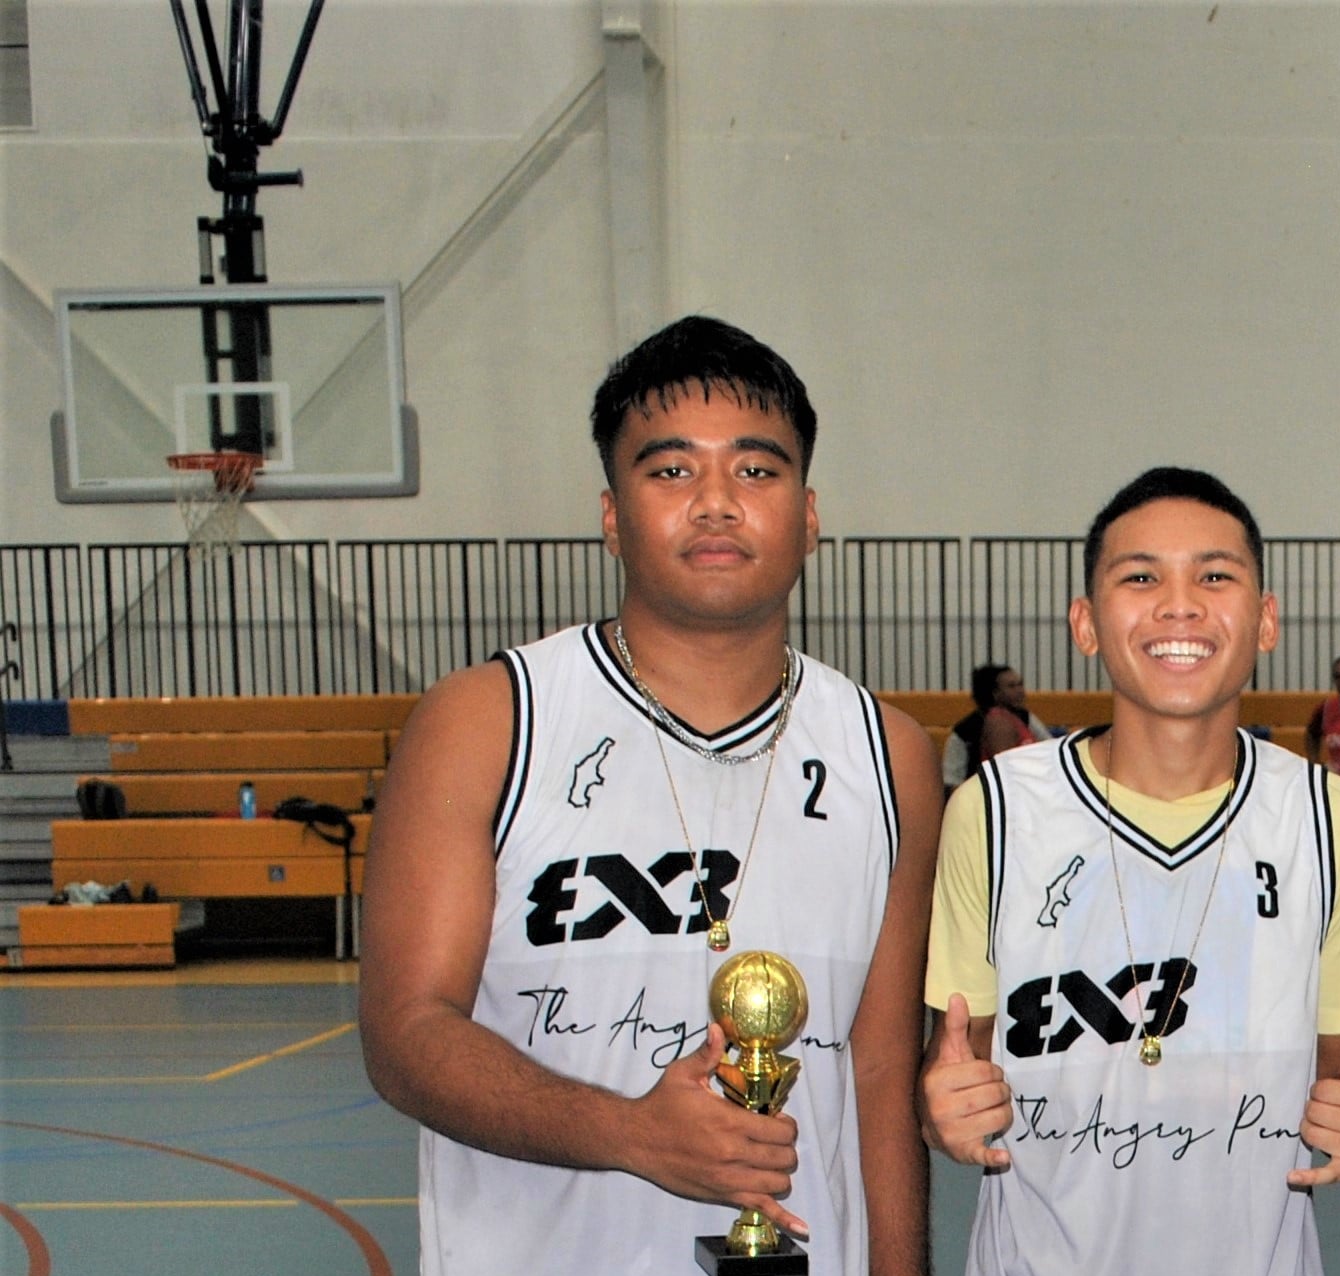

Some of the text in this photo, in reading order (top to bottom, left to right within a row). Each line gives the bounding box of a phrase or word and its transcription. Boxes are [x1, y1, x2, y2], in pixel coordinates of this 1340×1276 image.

[801, 758, 829, 822] 2
[1255, 860, 1280, 919] 3
[517, 984, 597, 1048] The
[607, 986, 709, 1069] Ang
[1069, 1092, 1216, 1170] Angry
[1226, 1093, 1303, 1156] Pen
